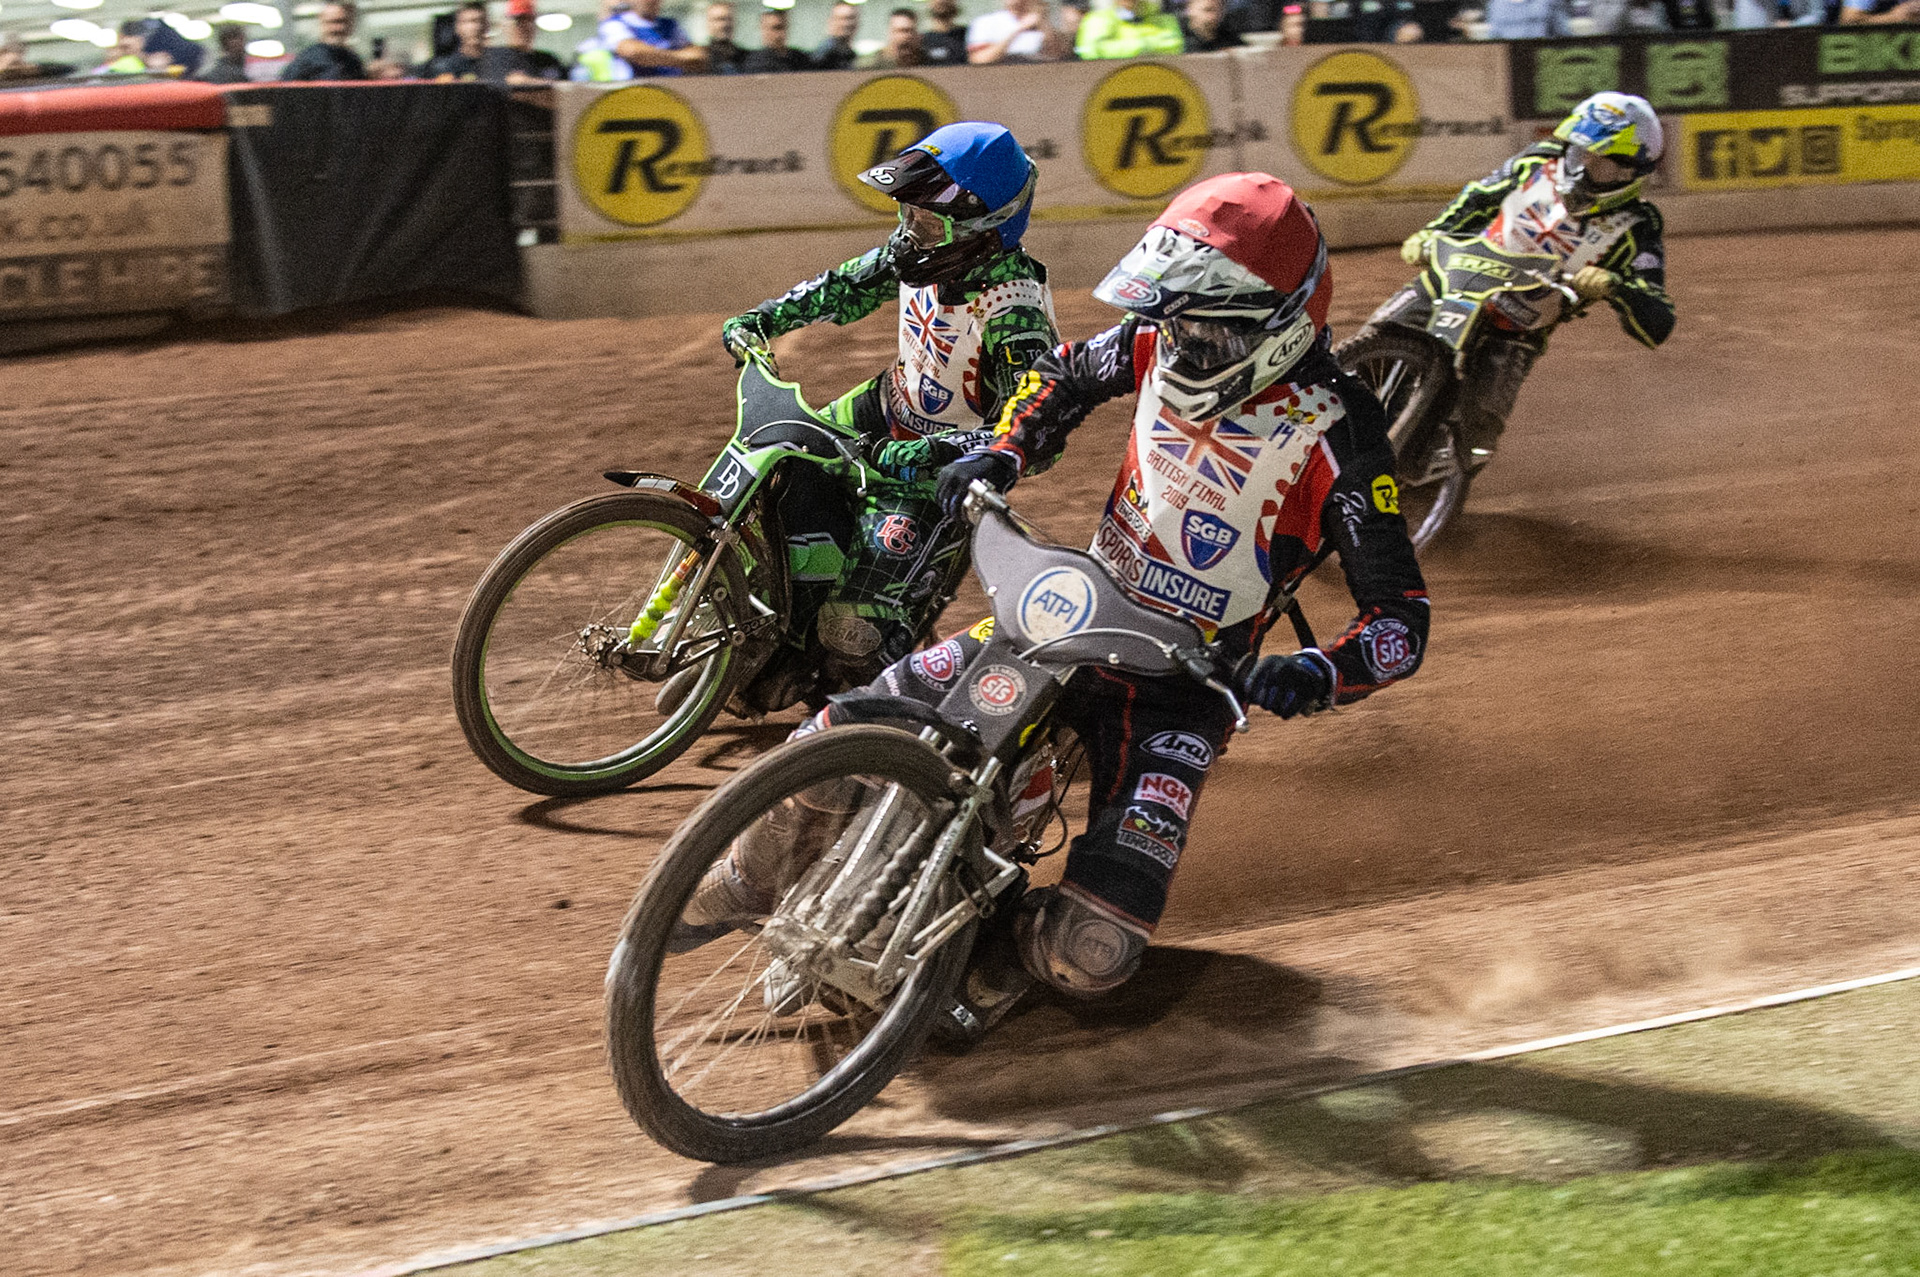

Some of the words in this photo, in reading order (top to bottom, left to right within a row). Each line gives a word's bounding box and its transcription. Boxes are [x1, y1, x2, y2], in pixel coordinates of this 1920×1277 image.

[1435, 310, 1467, 329] 37
[920, 378, 949, 400] SGB
[1268, 421, 1296, 450] 14
[1146, 449, 1191, 488] BRITISH
[1188, 479, 1228, 512] FINAL
[1160, 484, 1191, 511] 2019
[1186, 514, 1233, 545] SGB
[1097, 525, 1144, 583] SPORTS
[1142, 565, 1226, 617] INSURE
[1032, 589, 1079, 624] ATPI
[924, 647, 951, 673] STS
[1380, 633, 1405, 663] STS
[982, 677, 1011, 701] STS
[1158, 735, 1209, 763] Arai
[1141, 775, 1190, 804] NGK
